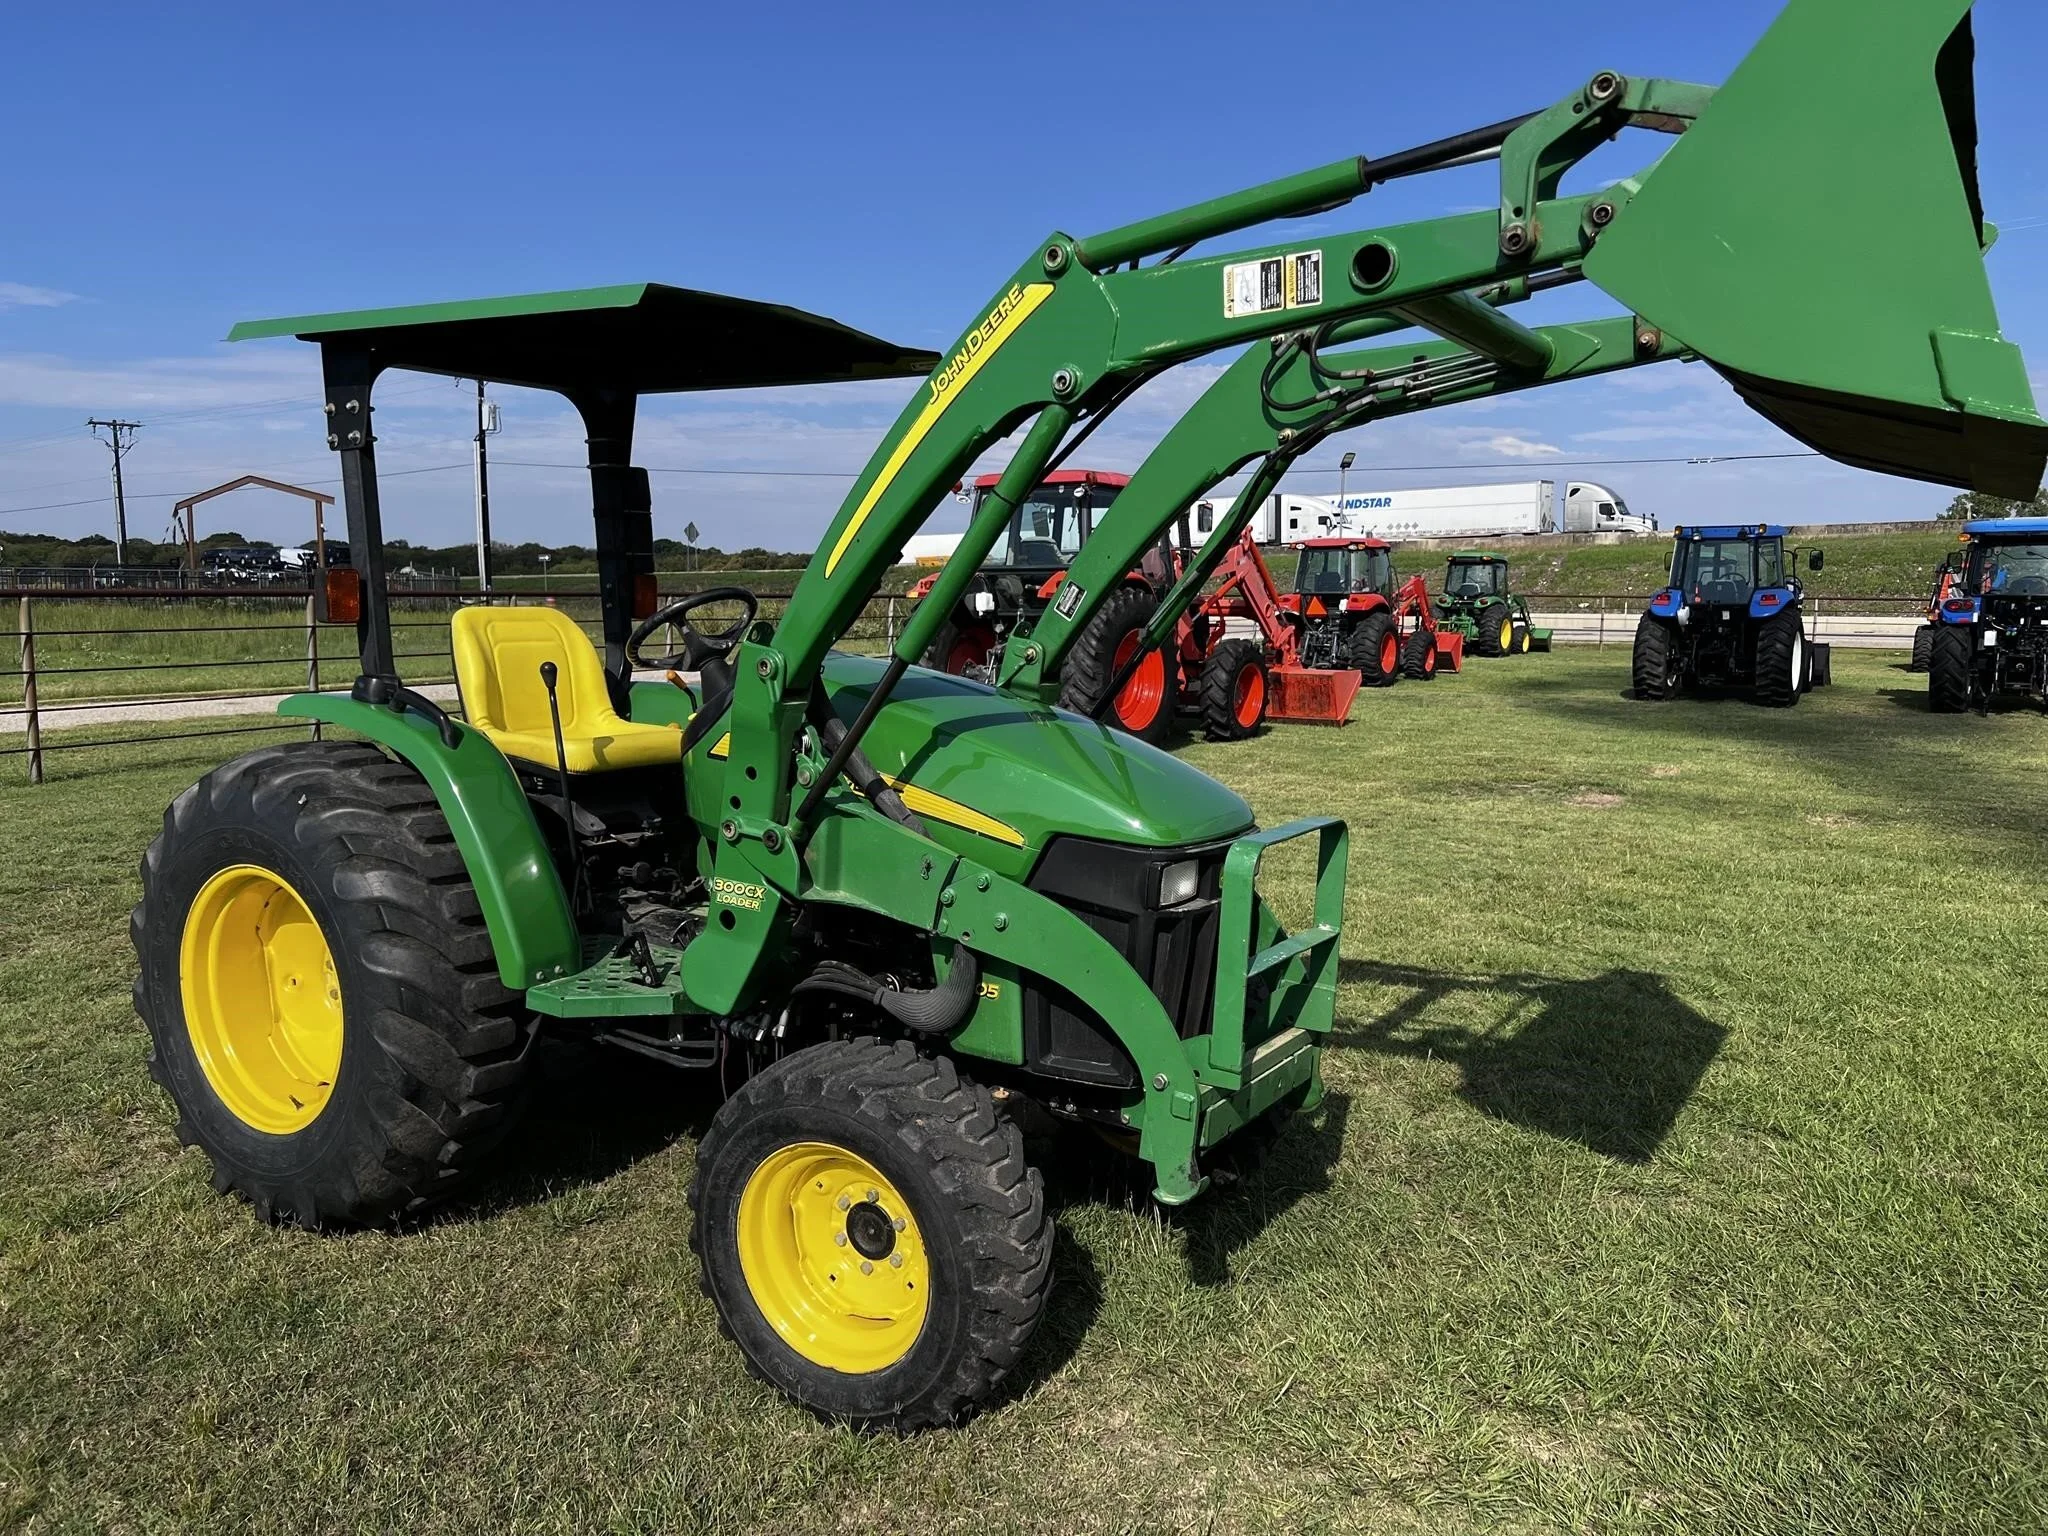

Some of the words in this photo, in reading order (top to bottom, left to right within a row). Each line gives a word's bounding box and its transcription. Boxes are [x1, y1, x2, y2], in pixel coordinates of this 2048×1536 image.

[929, 347, 970, 405] JOHN
[966, 283, 1024, 356] DEERE
[1331, 497, 1392, 510] ANDSTAR
[715, 879, 766, 900] 300CX
[716, 893, 760, 910] LOADER
